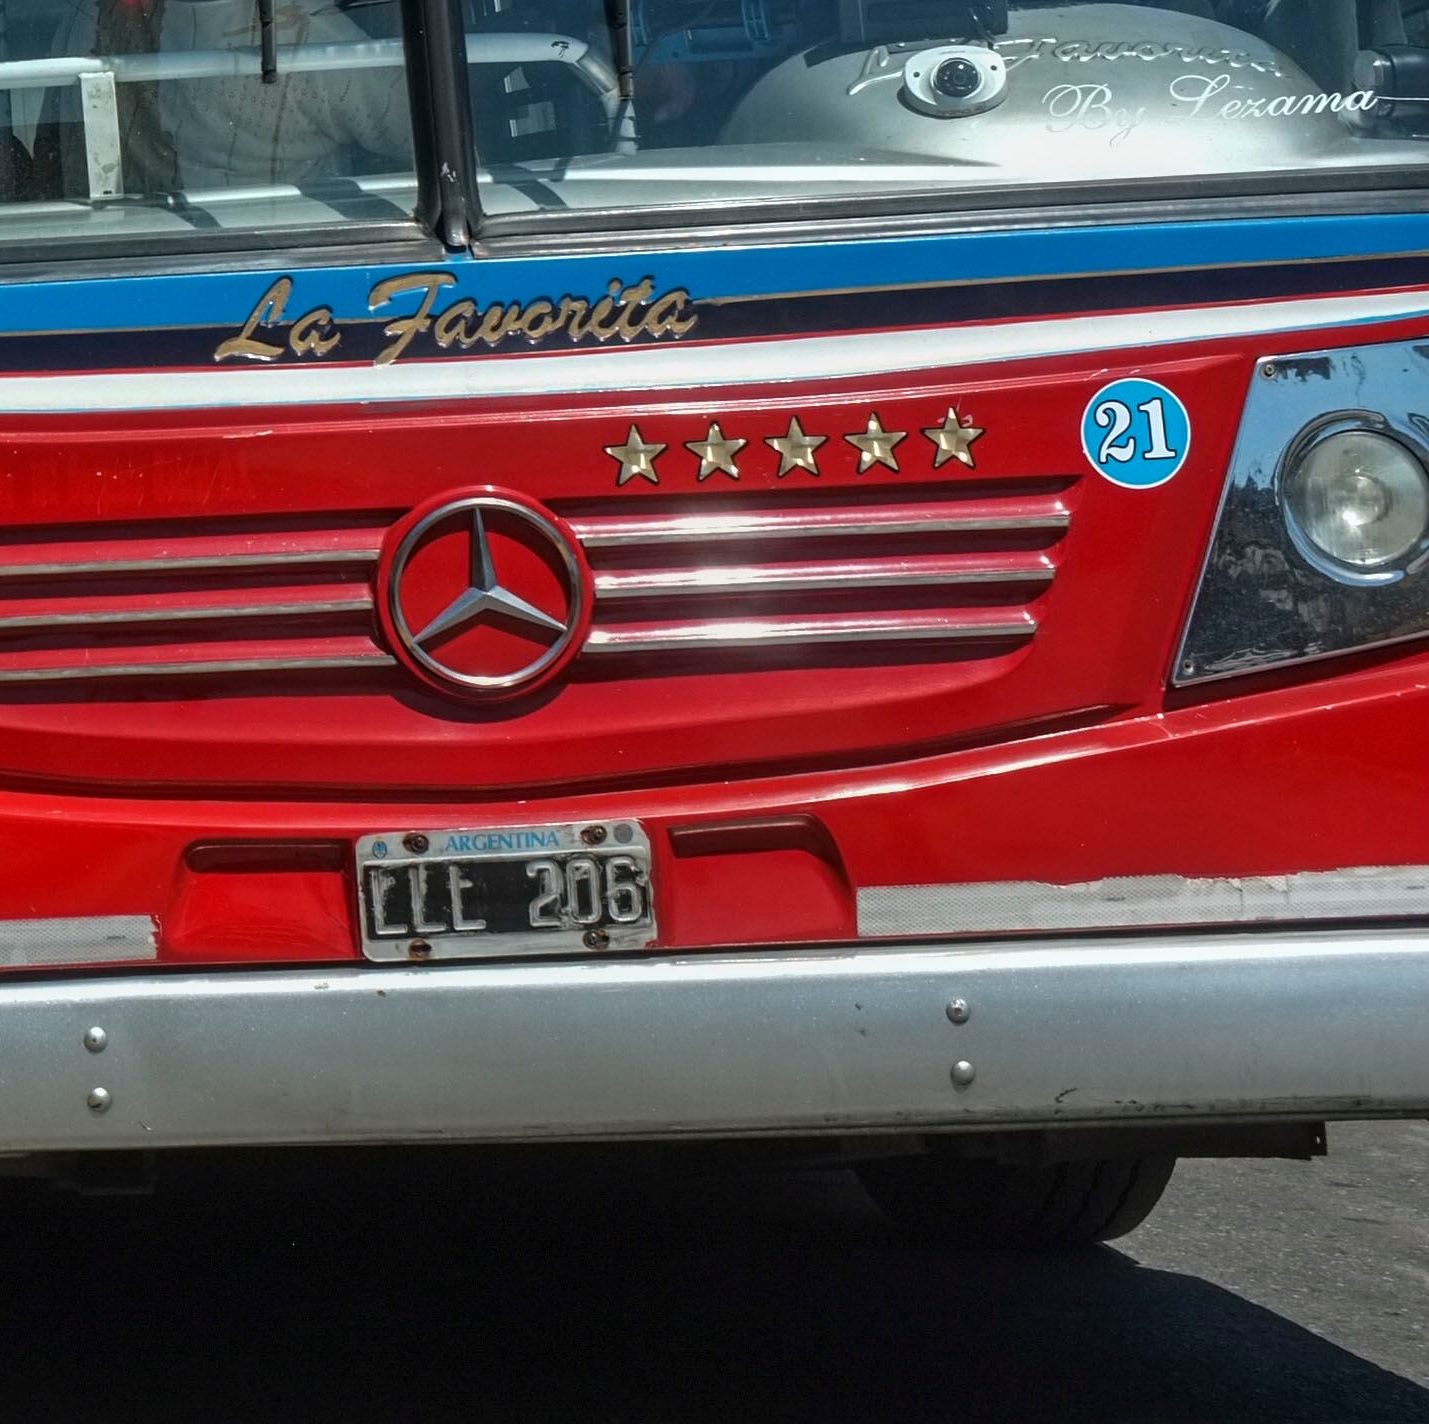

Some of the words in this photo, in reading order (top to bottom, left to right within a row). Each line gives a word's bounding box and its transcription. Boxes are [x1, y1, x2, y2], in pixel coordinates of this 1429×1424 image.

[1168, 74, 1378, 121] Lezama
[213, 275, 341, 362] La
[366, 271, 700, 367] Favorita
[1094, 396, 1177, 464] 21
[445, 830, 560, 853] ARGENTINA
[525, 854, 643, 928] 206
